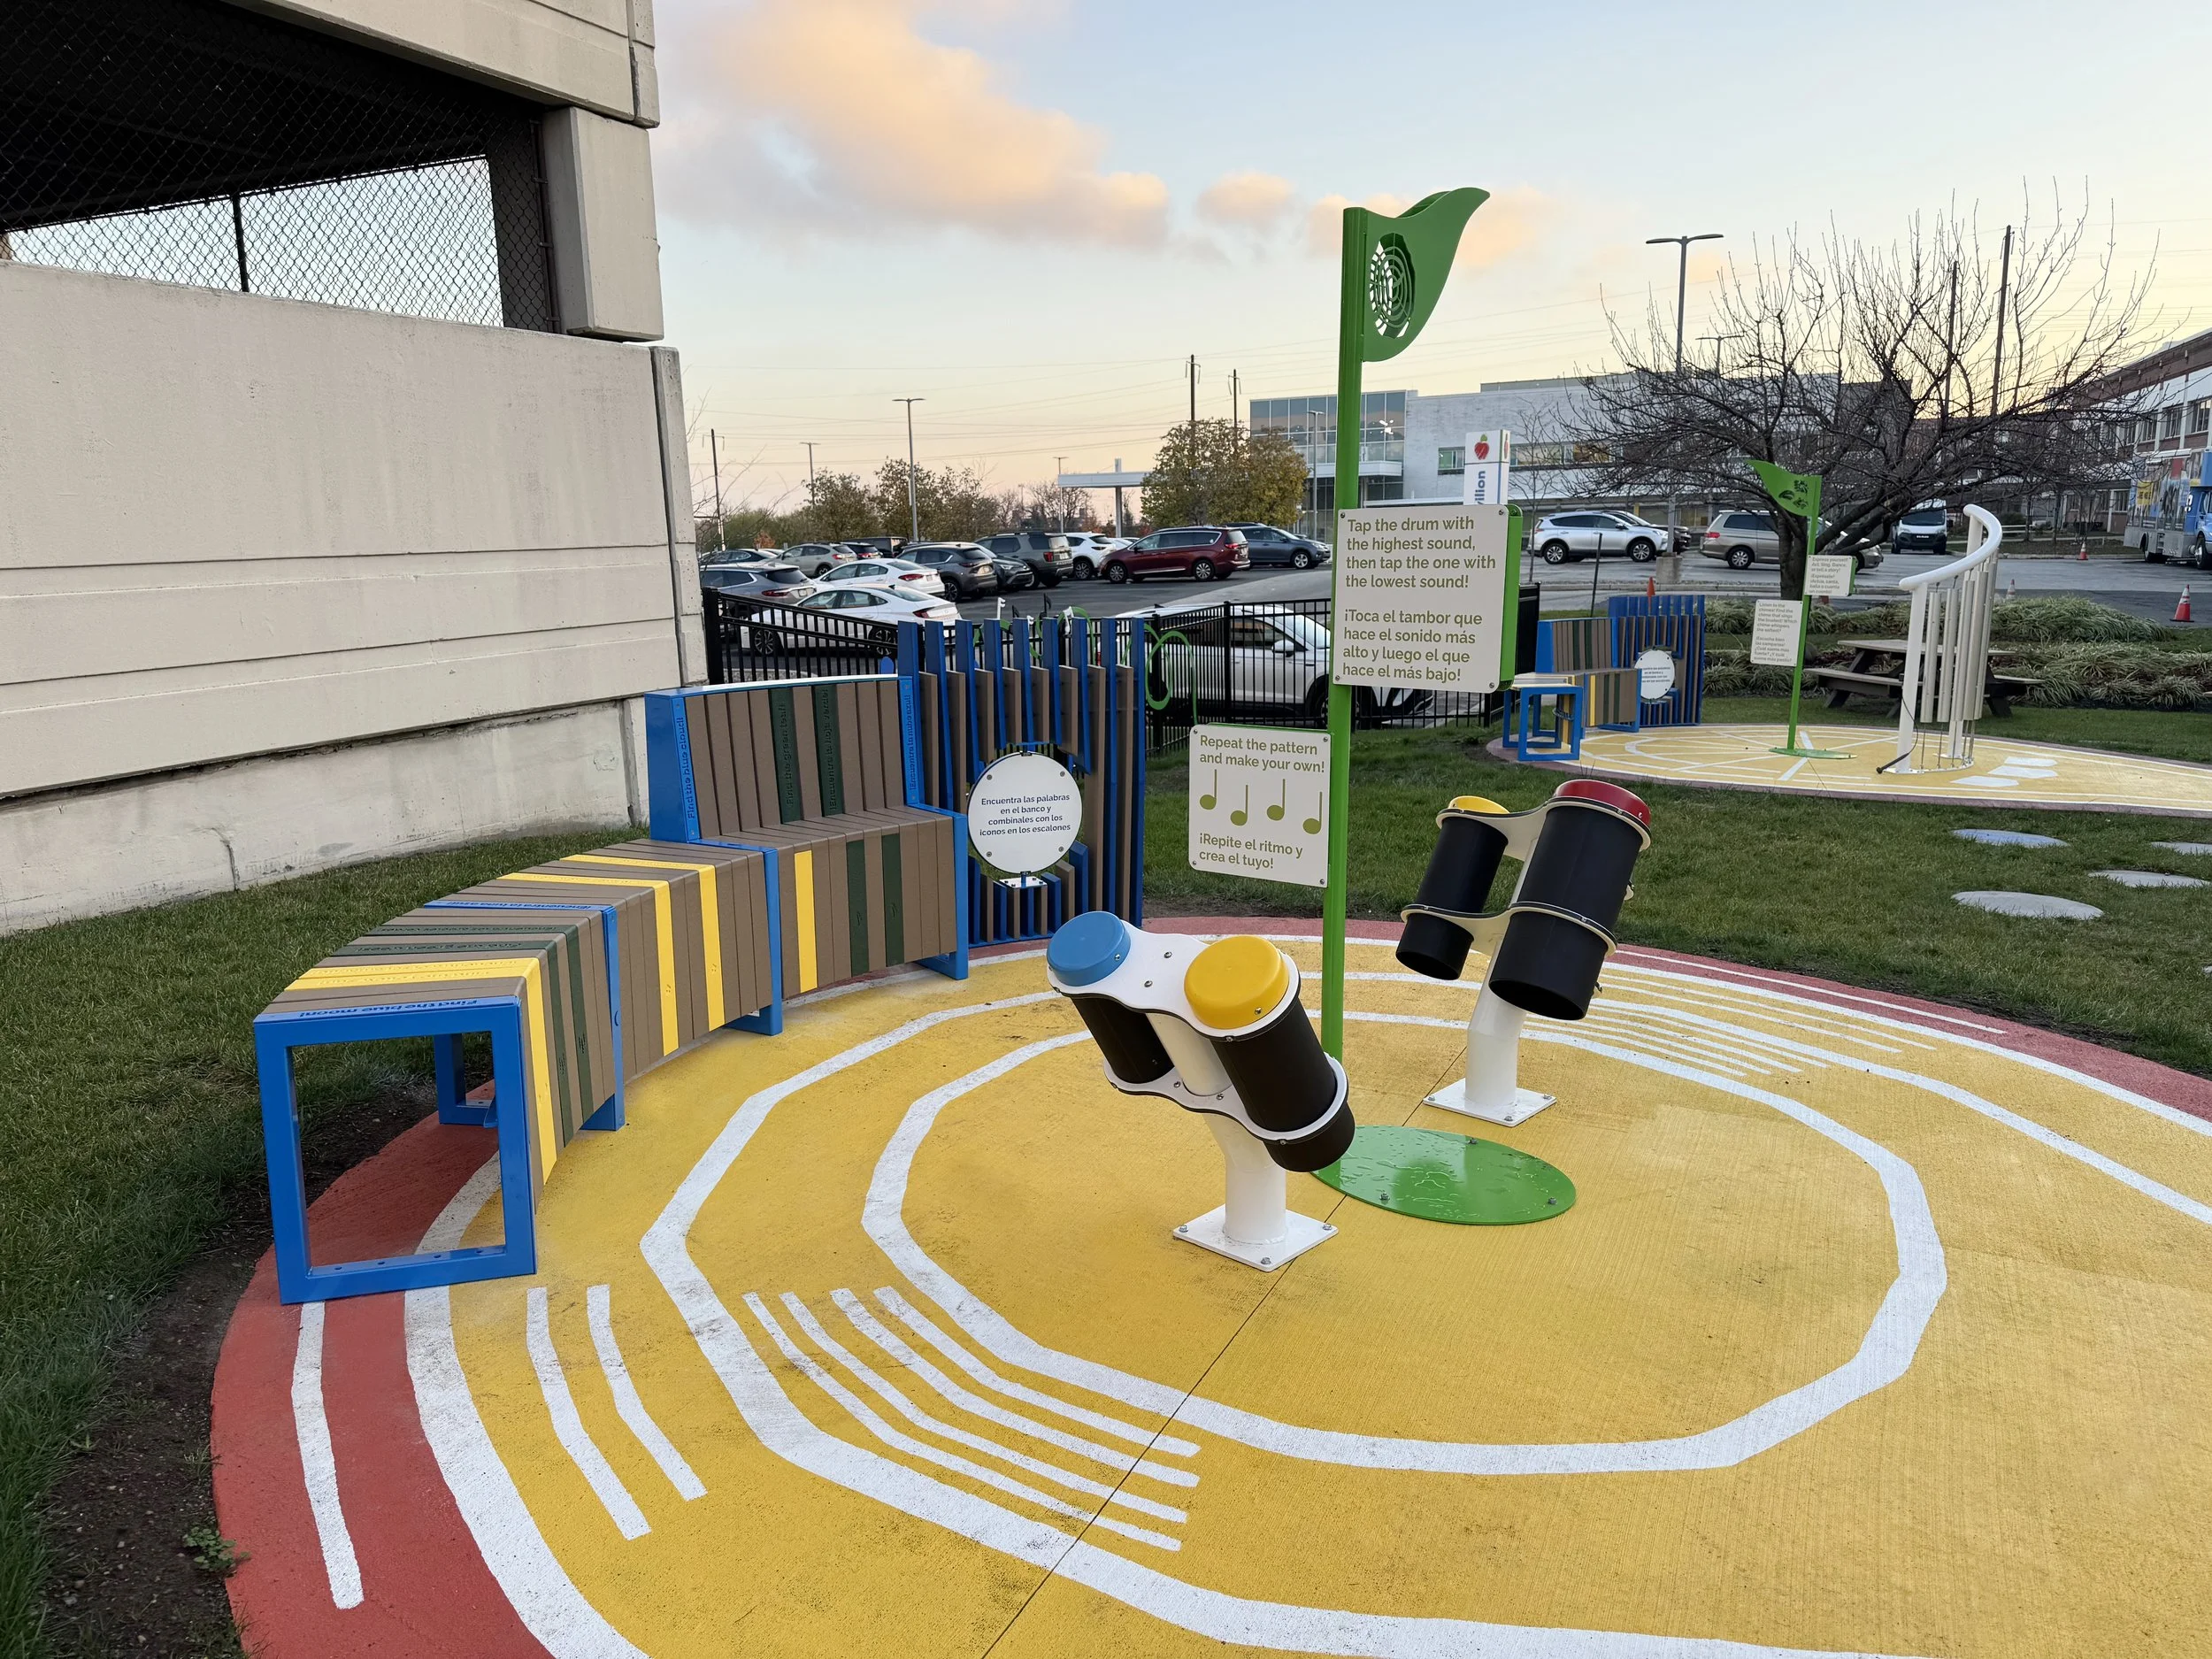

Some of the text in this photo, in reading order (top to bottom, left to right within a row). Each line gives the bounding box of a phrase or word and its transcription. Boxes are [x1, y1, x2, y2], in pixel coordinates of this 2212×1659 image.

[1348, 517, 1474, 534] Tap the drum with
[1348, 536, 1476, 553] the highest sound,
[1347, 555, 1495, 572] then tap the one with
[1346, 575, 1469, 588] the lowest sound!
[1345, 609, 1482, 628] ¡Toca el tambor que
[1344, 627, 1476, 644] hace el sonido más
[1343, 646, 1470, 665] alto y luego el que
[1343, 664, 1461, 683] hace el más bajo!
[676, 718, 687, 750] cloud!
[1201, 735, 1317, 755] Repeat the pattern
[1200, 753, 1325, 772] and make your own!
[981, 796, 1022, 805] Encuentra
[1037, 795, 1070, 804] palabras
[1200, 833, 1302, 859] ¡Repite el ritmo y
[1200, 851, 1273, 870] crea el tuyo!
